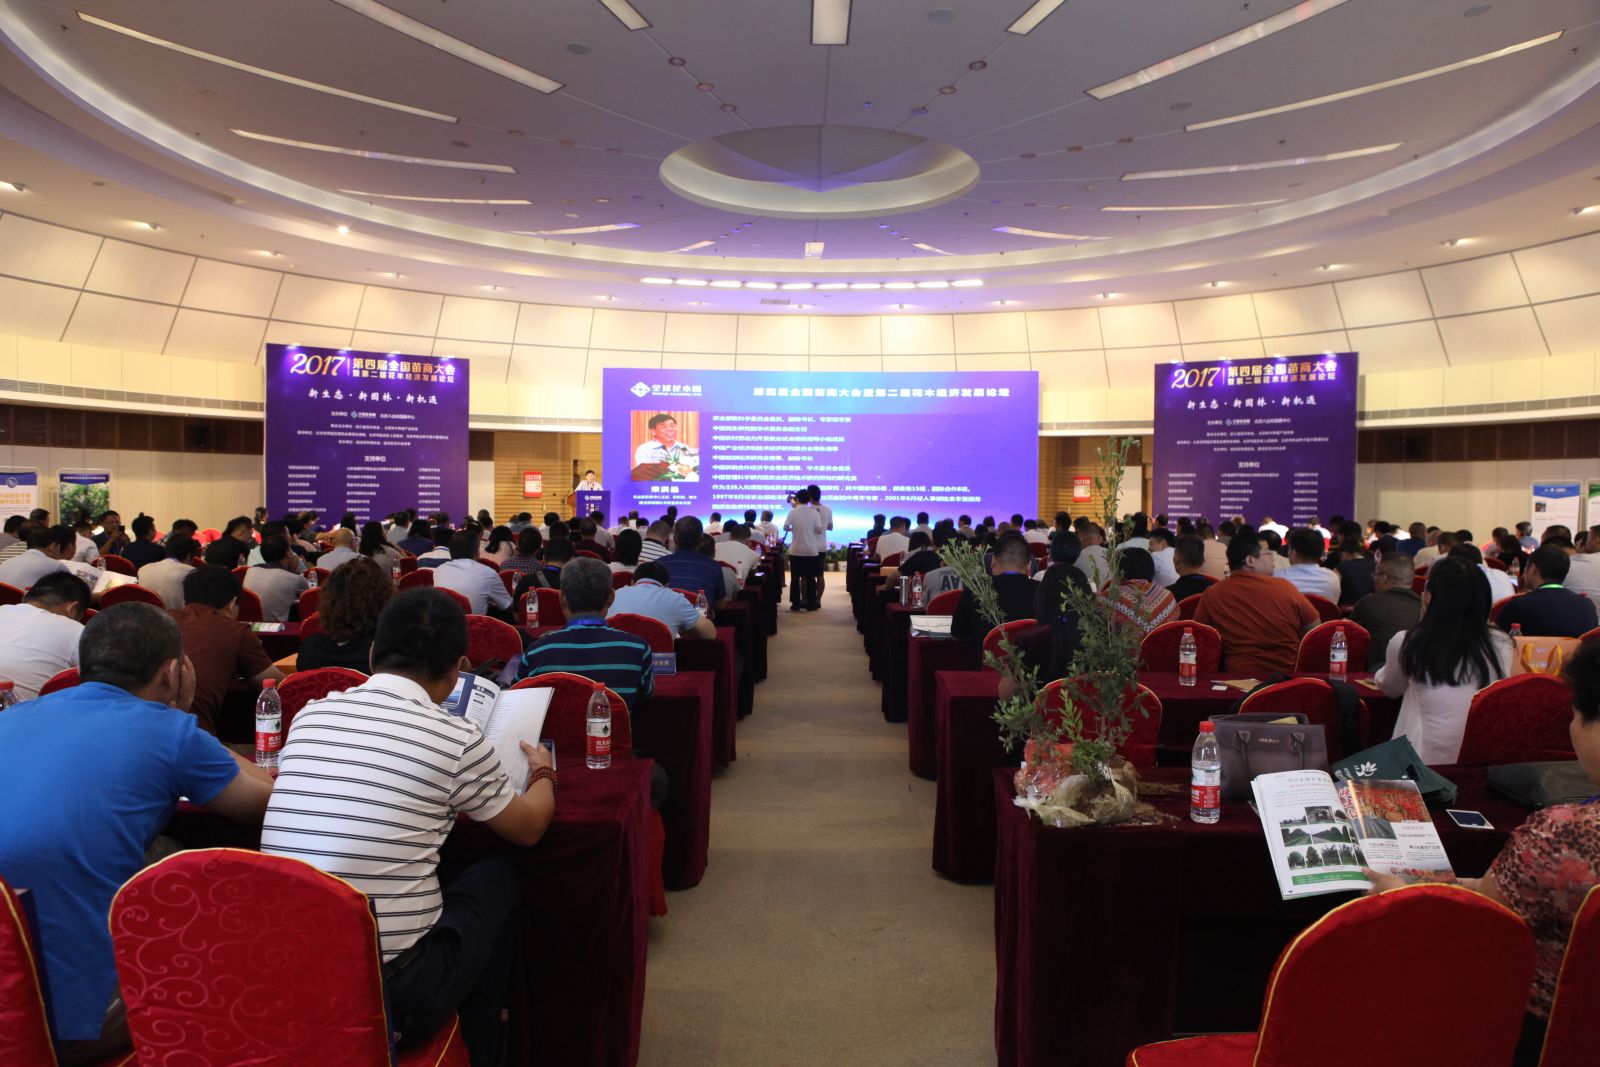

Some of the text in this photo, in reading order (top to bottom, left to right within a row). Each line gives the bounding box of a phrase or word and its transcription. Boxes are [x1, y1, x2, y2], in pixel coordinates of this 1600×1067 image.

[290, 353, 346, 377] 2017
[352, 357, 455, 375] 第四届全国苗商大会
[1228, 360, 1337, 377] 第四届全国苗商大会
[1171, 366, 1221, 389] 2017
